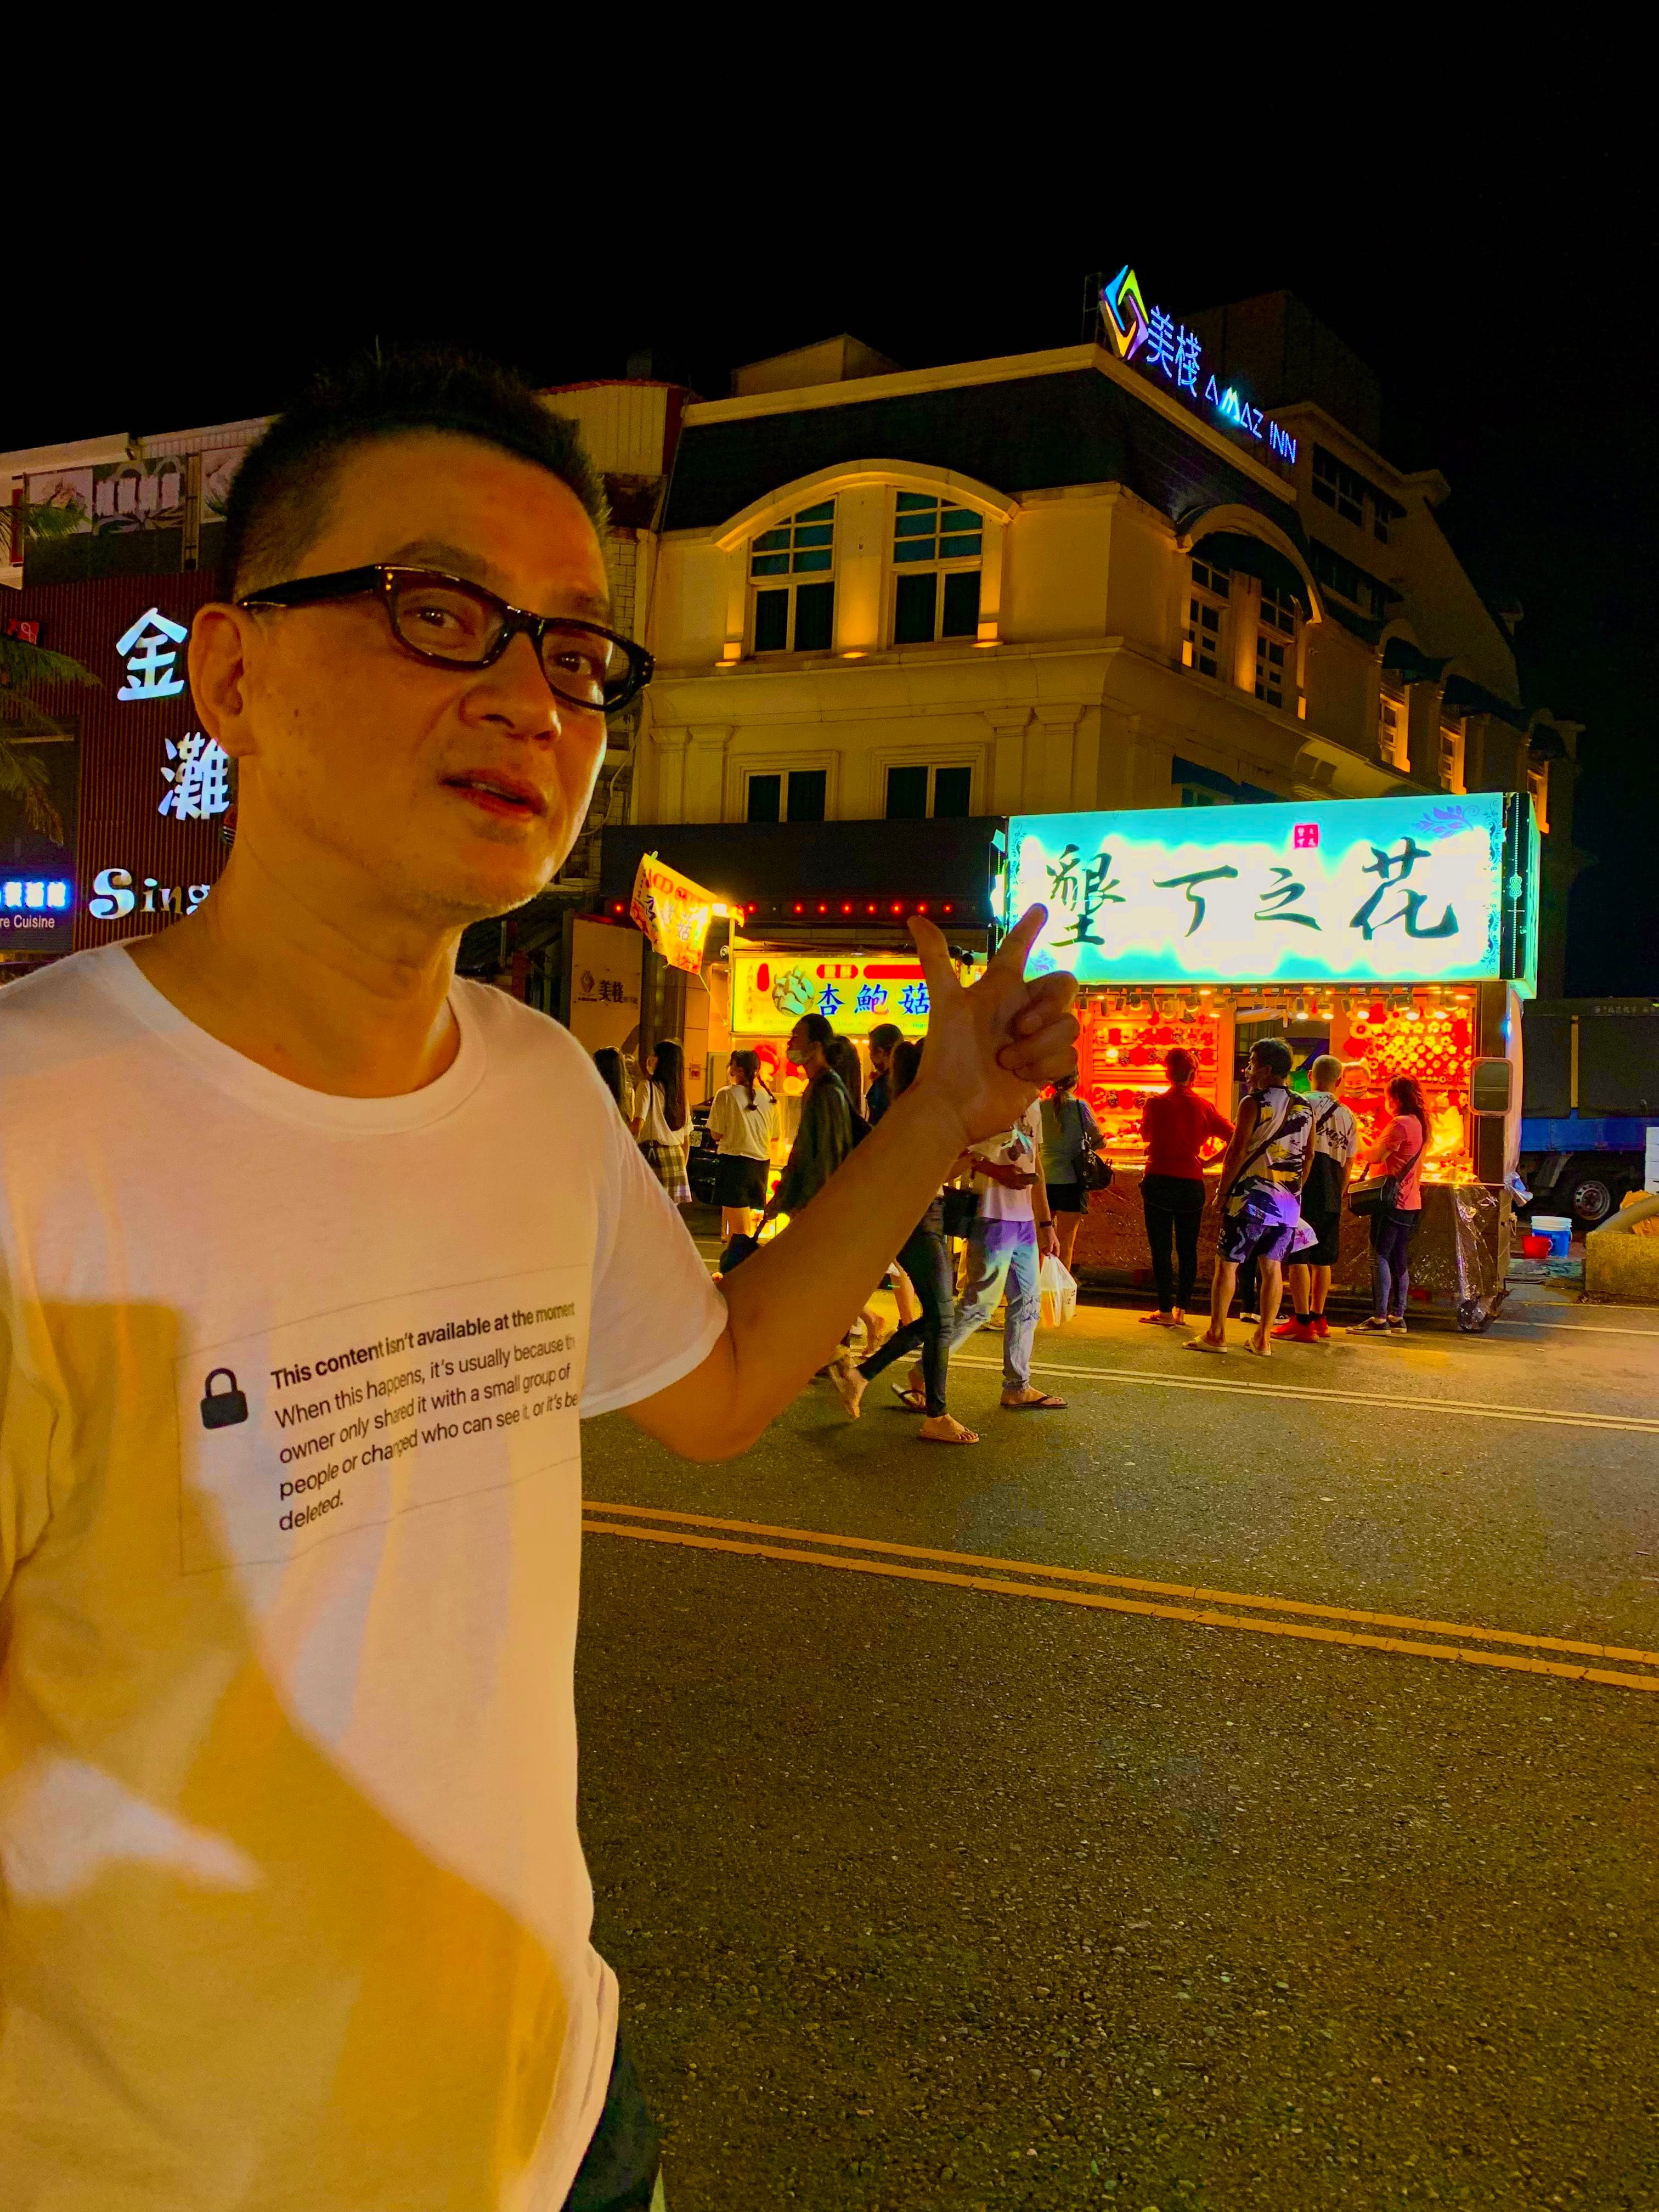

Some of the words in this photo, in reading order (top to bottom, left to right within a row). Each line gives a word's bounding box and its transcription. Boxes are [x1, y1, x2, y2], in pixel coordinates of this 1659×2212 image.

[1269, 421, 1296, 464] INN
[116, 607, 188, 701] 金
[14, 915, 55, 928] Cuisine
[1046, 836, 1460, 947] 墾丁之花
[816, 983, 931, 1017] 杏鮑菇
[270, 1364, 312, 1390] This
[315, 1341, 385, 1376] content
[386, 1330, 414, 1356] isn't
[417, 1318, 491, 1346] available
[494, 1313, 509, 1331] at
[512, 1310, 534, 1328] the
[275, 1399, 331, 1428] When
[335, 1386, 363, 1410] this
[366, 1369, 426, 1400] happens,
[430, 1359, 454, 1379] it's
[459, 1348, 511, 1373] usually
[514, 1338, 563, 1362] because
[280, 1432, 335, 1463] owner
[340, 1417, 370, 1443] only
[374, 1398, 414, 1429] shared
[418, 1396, 427, 1413] it
[431, 1387, 466, 1410] with
[470, 1388, 480, 1401] a
[484, 1374, 520, 1399] small
[522, 1370, 556, 1393] group
[558, 1363, 571, 1381] of
[280, 1463, 339, 1500] people
[342, 1455, 358, 1474] or
[421, 1423, 459, 1443] who
[462, 1417, 492, 1435] can
[496, 1409, 520, 1427] see
[533, 1401, 544, 1416] or
[279, 1489, 344, 1531] deleted.
